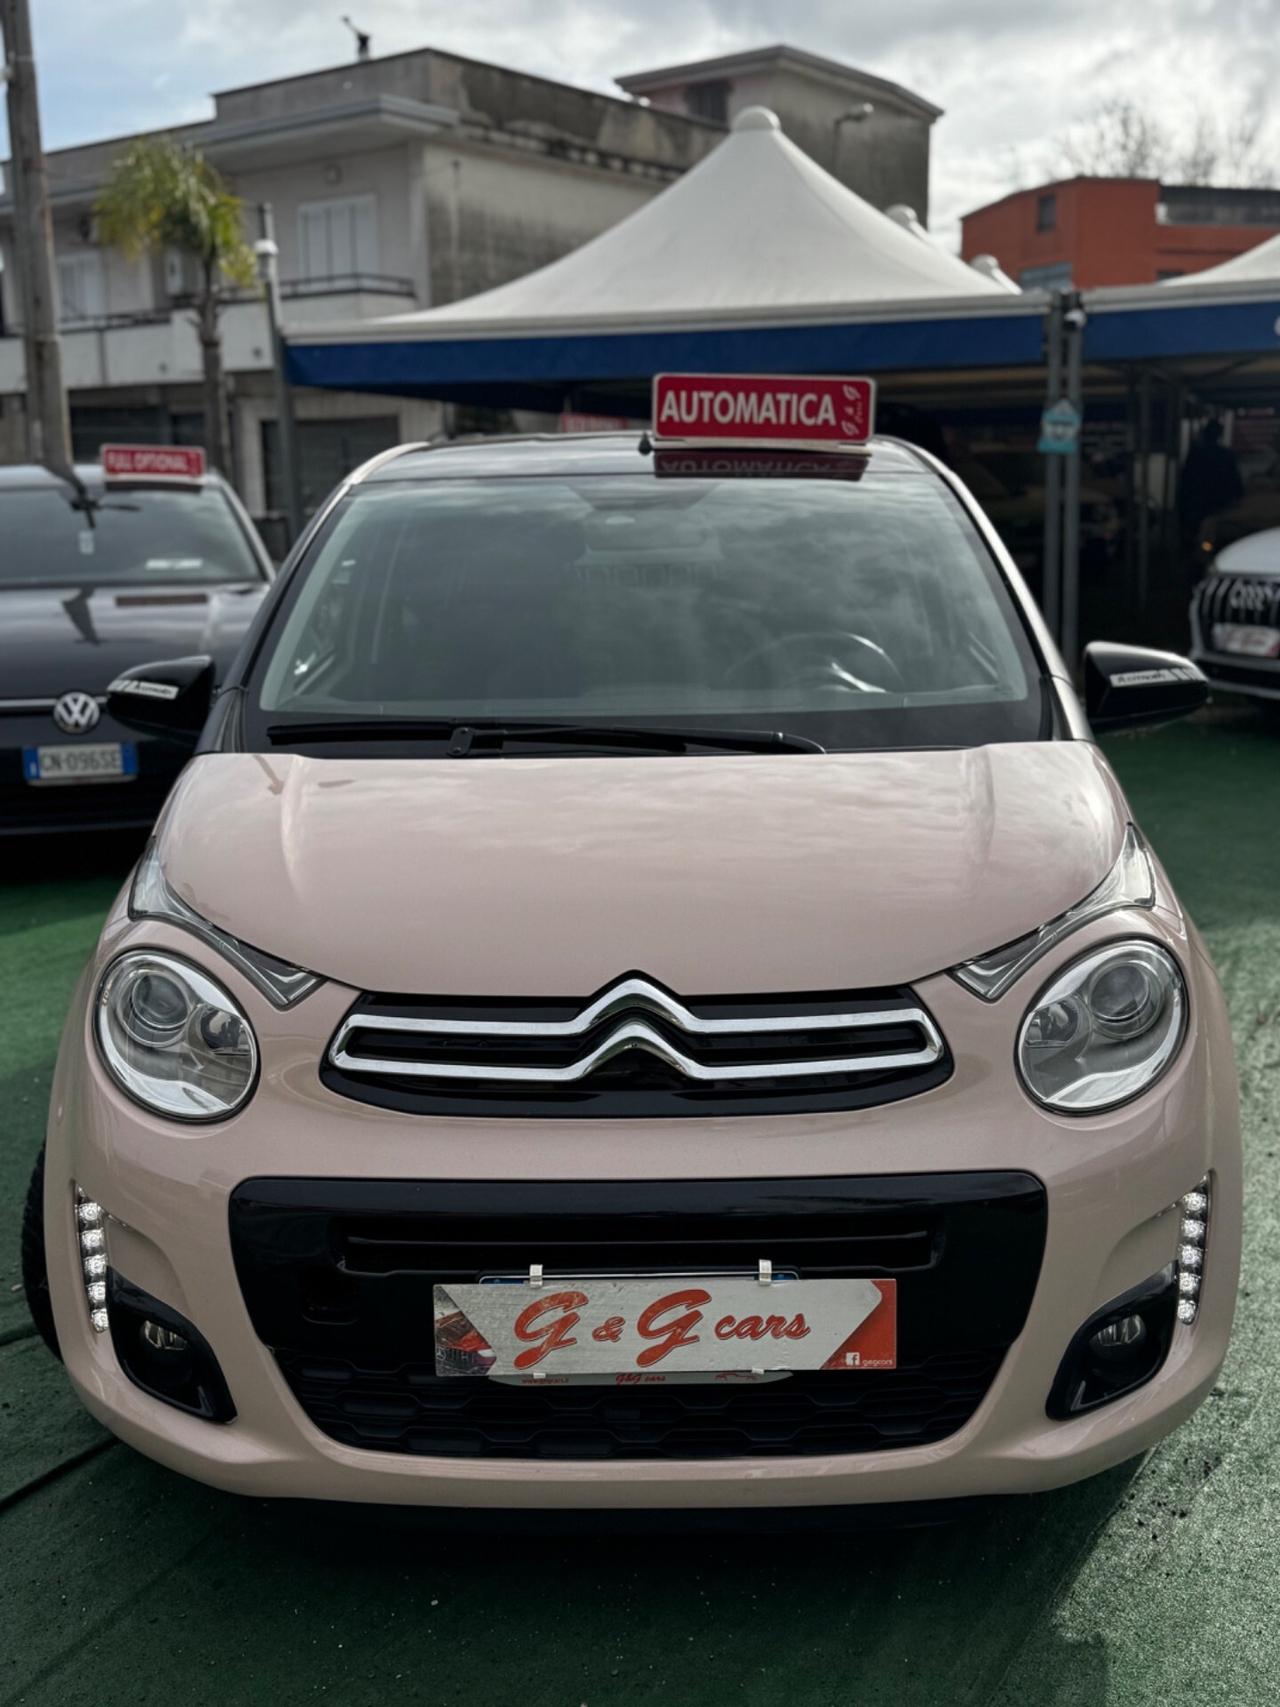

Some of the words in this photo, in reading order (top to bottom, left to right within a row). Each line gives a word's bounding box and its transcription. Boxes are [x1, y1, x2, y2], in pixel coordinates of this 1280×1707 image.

[659, 389, 837, 426] AUTOMATICA
[513, 1290, 589, 1370] G
[592, 1315, 626, 1342] &
[636, 1288, 712, 1368] G
[714, 1311, 811, 1341] cars
